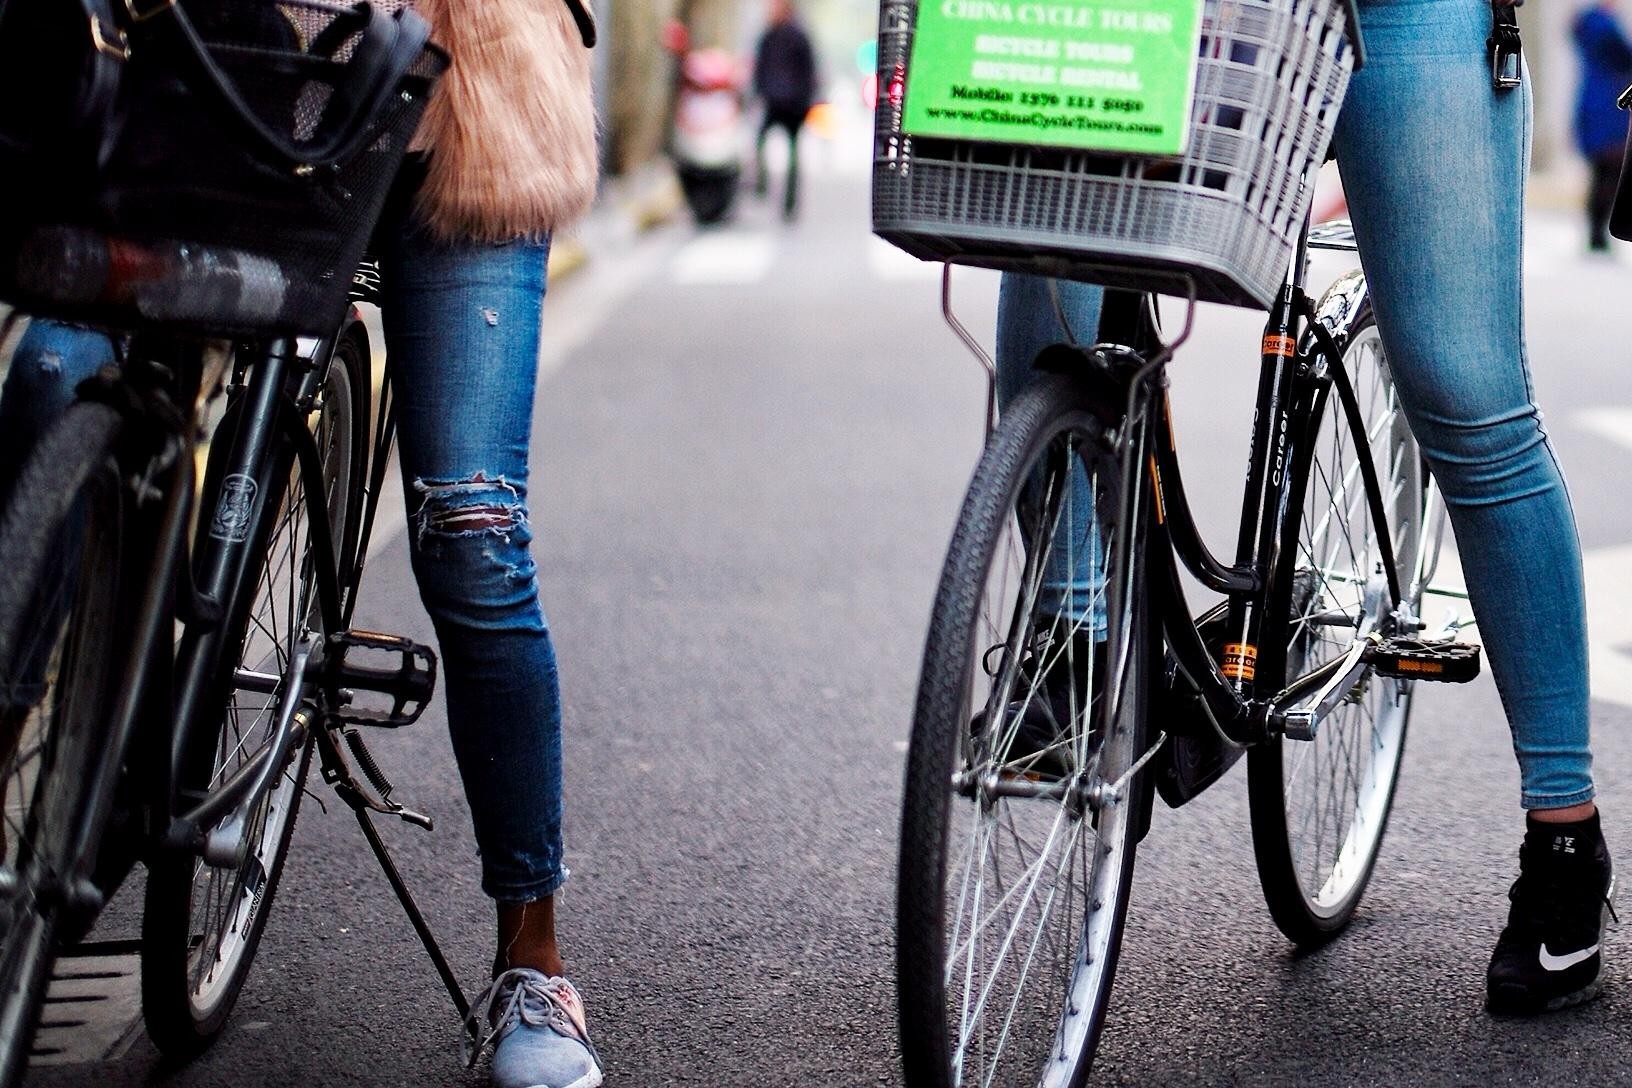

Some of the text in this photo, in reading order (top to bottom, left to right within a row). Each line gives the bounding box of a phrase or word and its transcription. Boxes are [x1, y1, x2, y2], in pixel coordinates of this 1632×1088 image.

[1018, 3, 1093, 28] CYCLE
[1101, 9, 1173, 34] TOURS
[975, 35, 1134, 64] BICYCLE TOURS
[971, 60, 1142, 91] BICYCLE RENTAL
[1066, 95, 1095, 109] 111
[1273, 411, 1287, 486] Career
